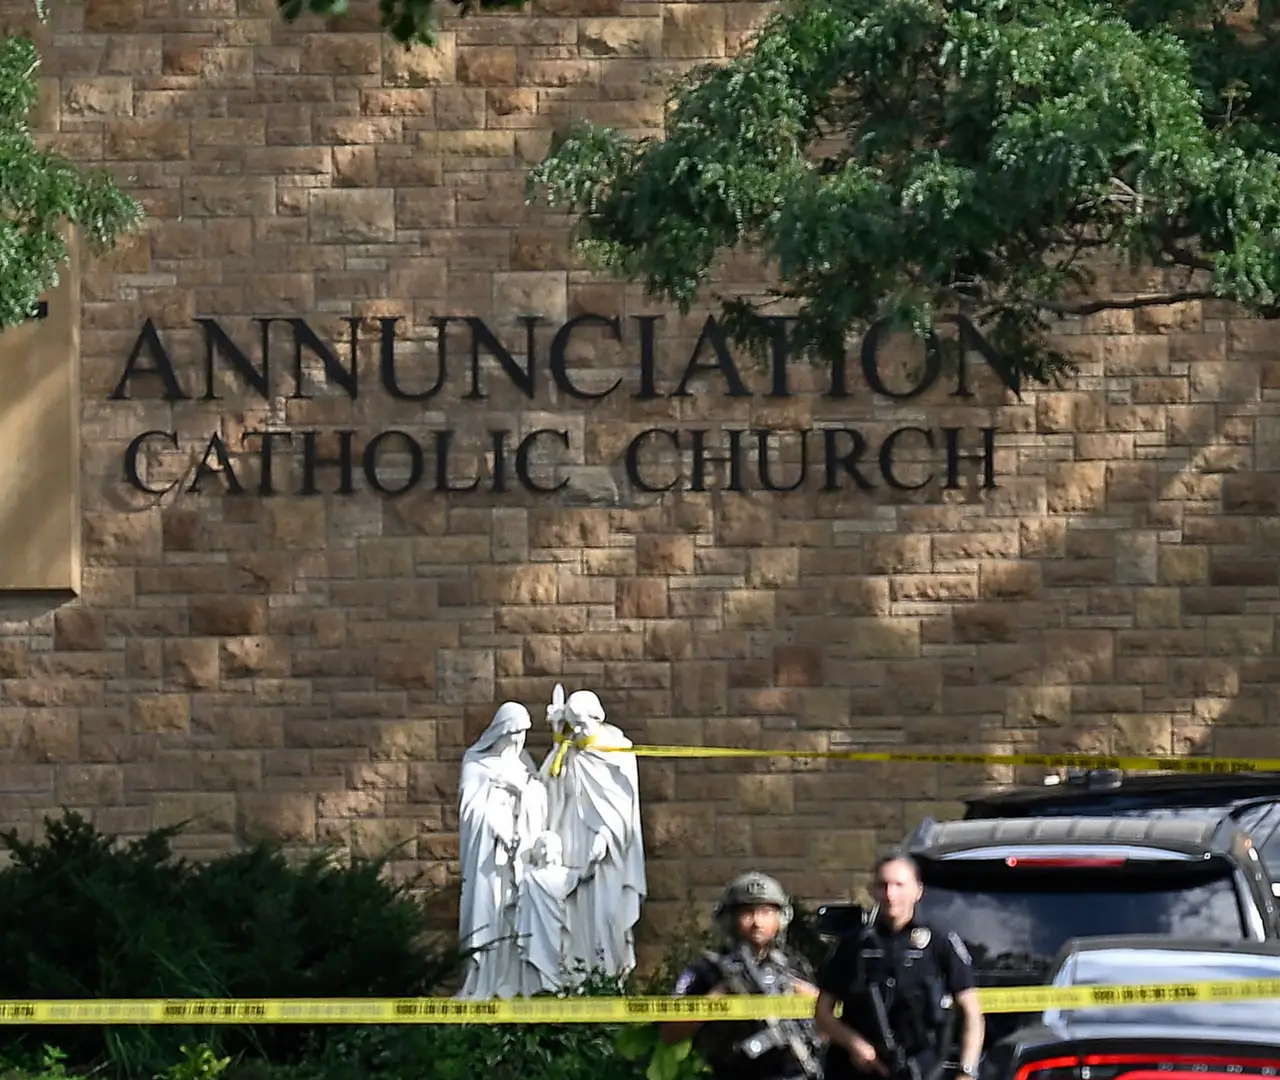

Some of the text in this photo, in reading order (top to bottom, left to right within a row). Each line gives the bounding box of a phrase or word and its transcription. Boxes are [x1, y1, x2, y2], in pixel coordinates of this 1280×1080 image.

[107, 312, 1024, 402] ANNUNCIATION
[123, 426, 1001, 496] CATHOLIC CHURCH
